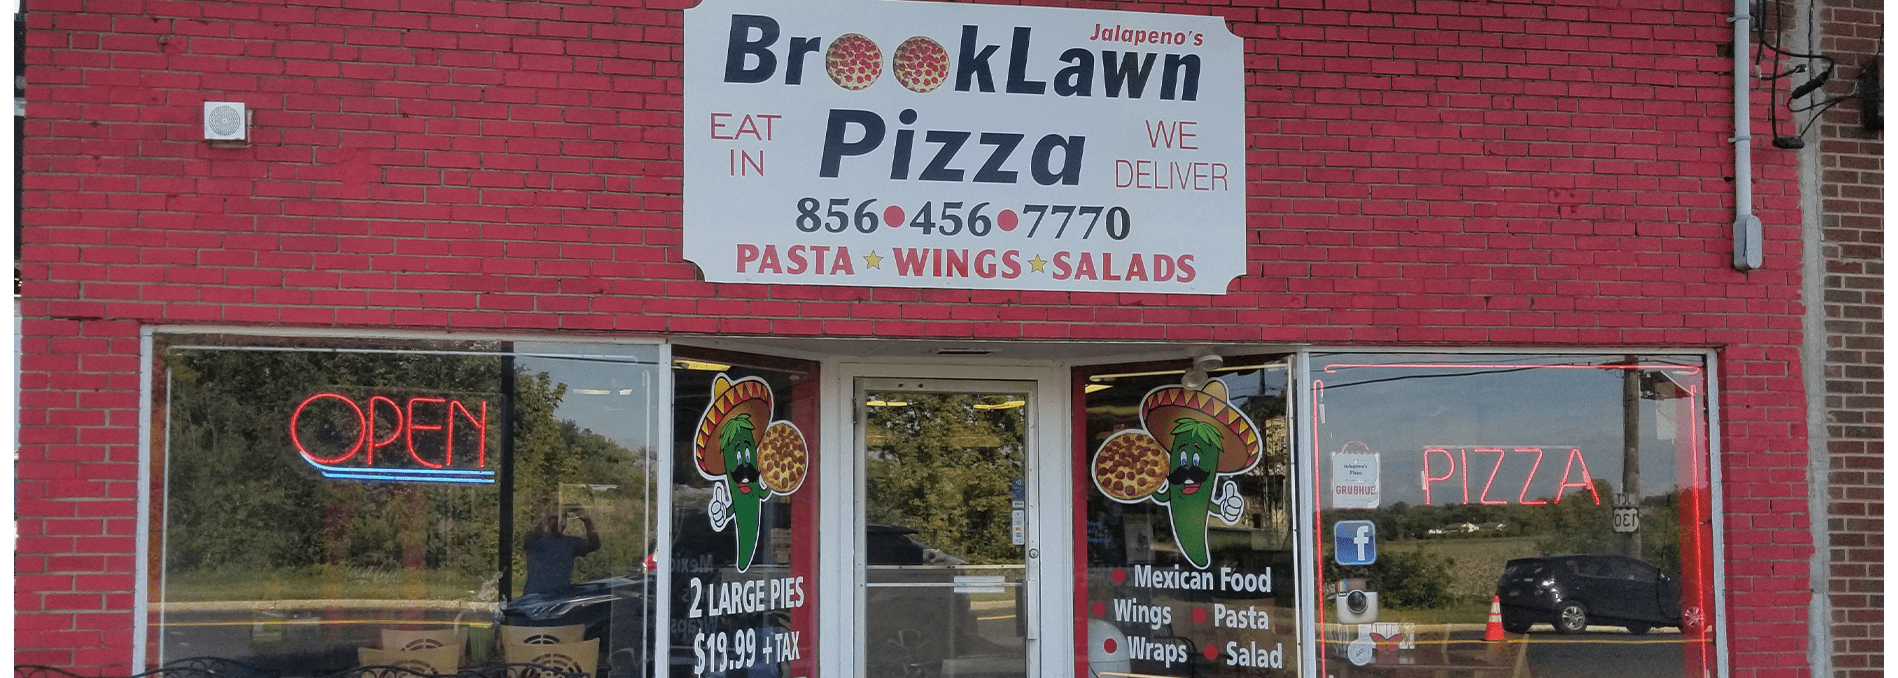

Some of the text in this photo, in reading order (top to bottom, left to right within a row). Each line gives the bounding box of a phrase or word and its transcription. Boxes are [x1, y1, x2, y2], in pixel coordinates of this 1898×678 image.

[1090, 23, 1204, 46] Jalapeno's
[710, 112, 782, 142] EAT
[1145, 119, 1199, 150] WE
[730, 149, 764, 177] IN
[819, 108, 1086, 186] Pizza
[1115, 159, 1229, 192] DELIVER
[736, 244, 1197, 283] PASTA WINGS SALADS
[290, 392, 487, 469] OPEN
[1335, 485, 1377, 495] GRUBHUB
[1423, 447, 1601, 505] PIZZA
[1134, 564, 1272, 593] Mexican Food
[689, 577, 703, 618] 2
[708, 580, 765, 616] LARGE
[770, 576, 805, 610] PIES
[1113, 597, 1269, 630] Wings Pasta
[694, 627, 756, 678] $19.99
[1128, 635, 1283, 669] Wraps Salad
